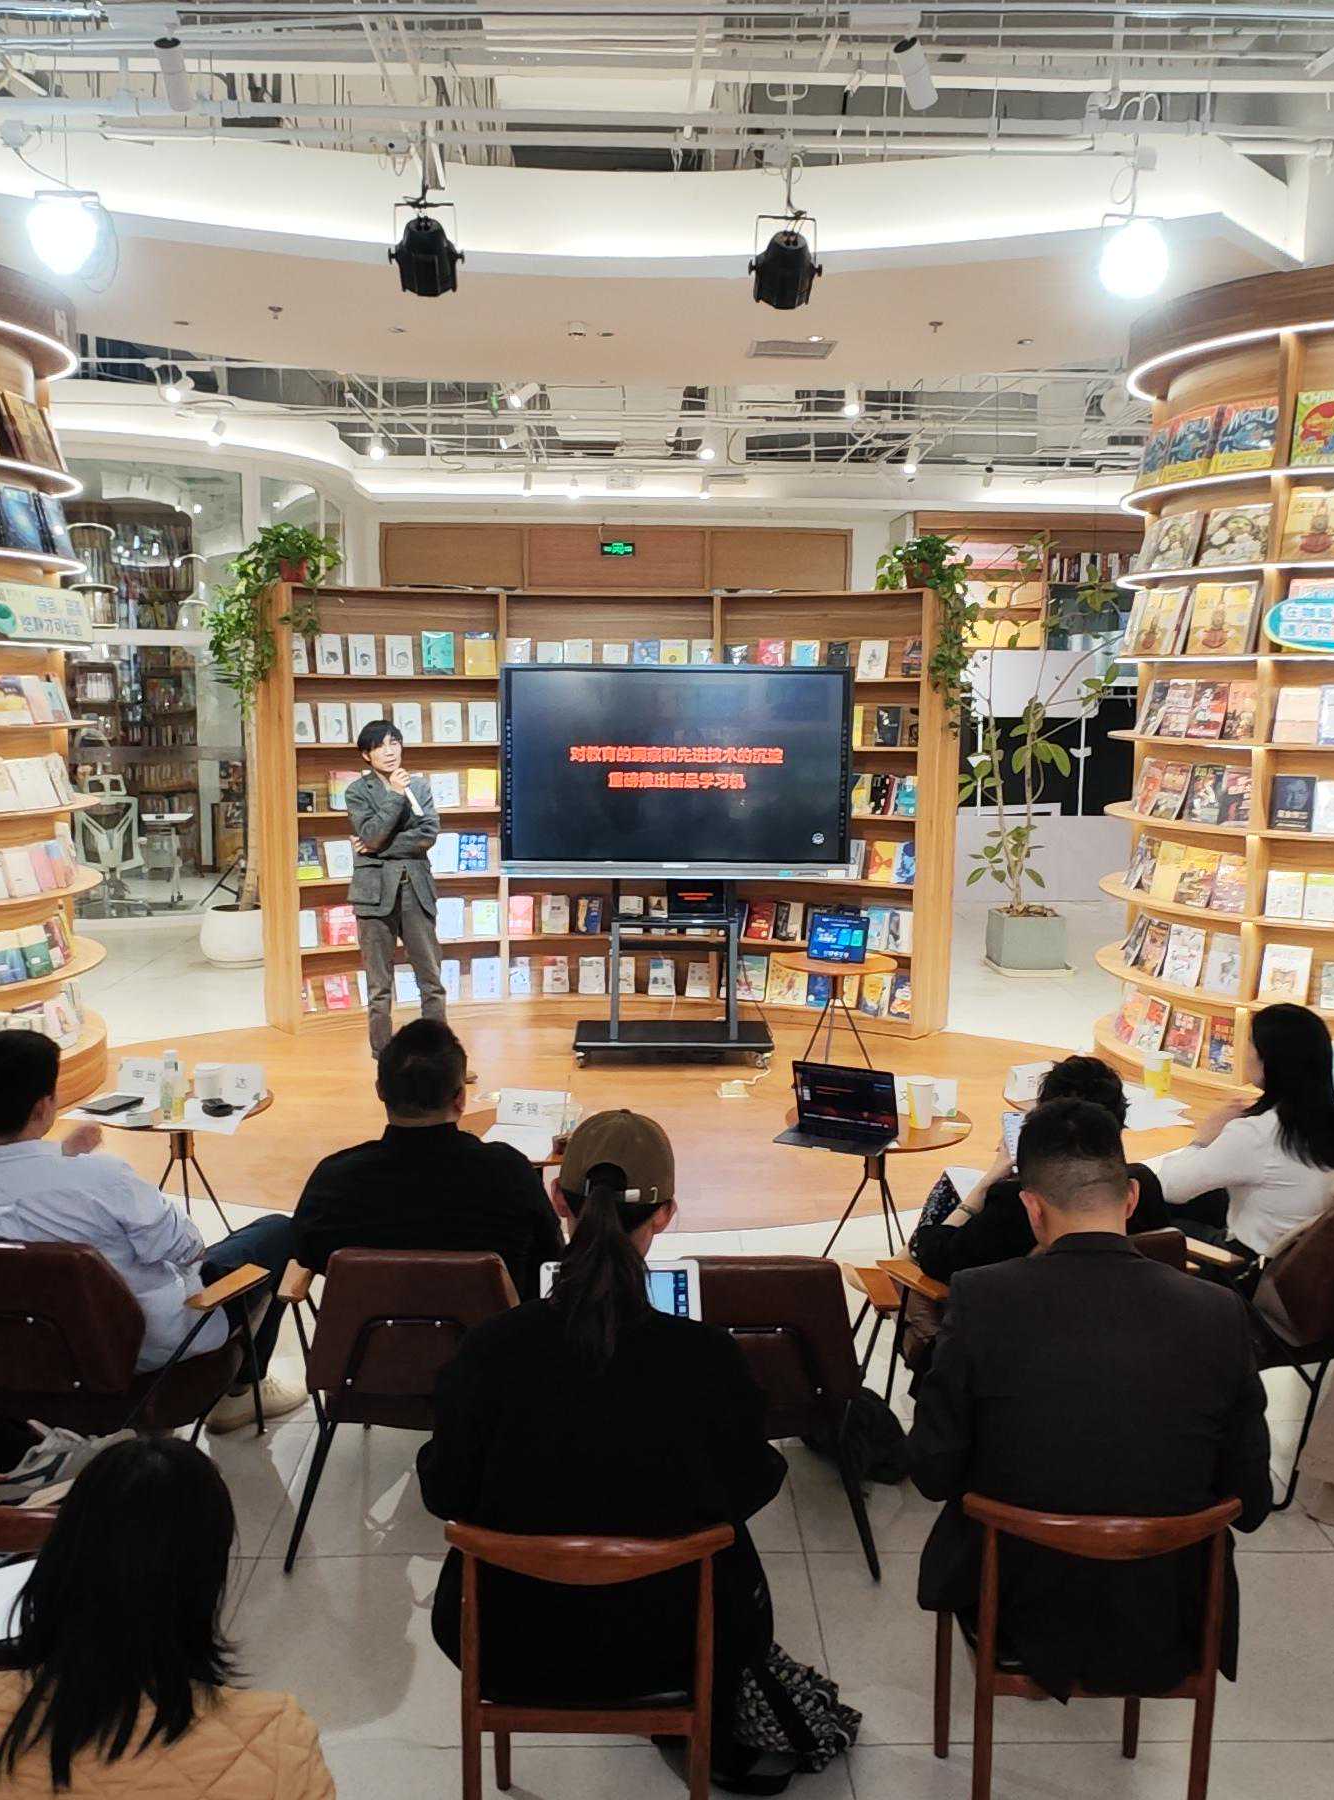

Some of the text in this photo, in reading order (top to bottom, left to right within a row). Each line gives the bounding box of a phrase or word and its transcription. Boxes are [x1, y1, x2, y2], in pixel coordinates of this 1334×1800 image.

[1228, 405, 1278, 433] WORLD
[607, 772, 747, 790] 重磅推出新品学习机
